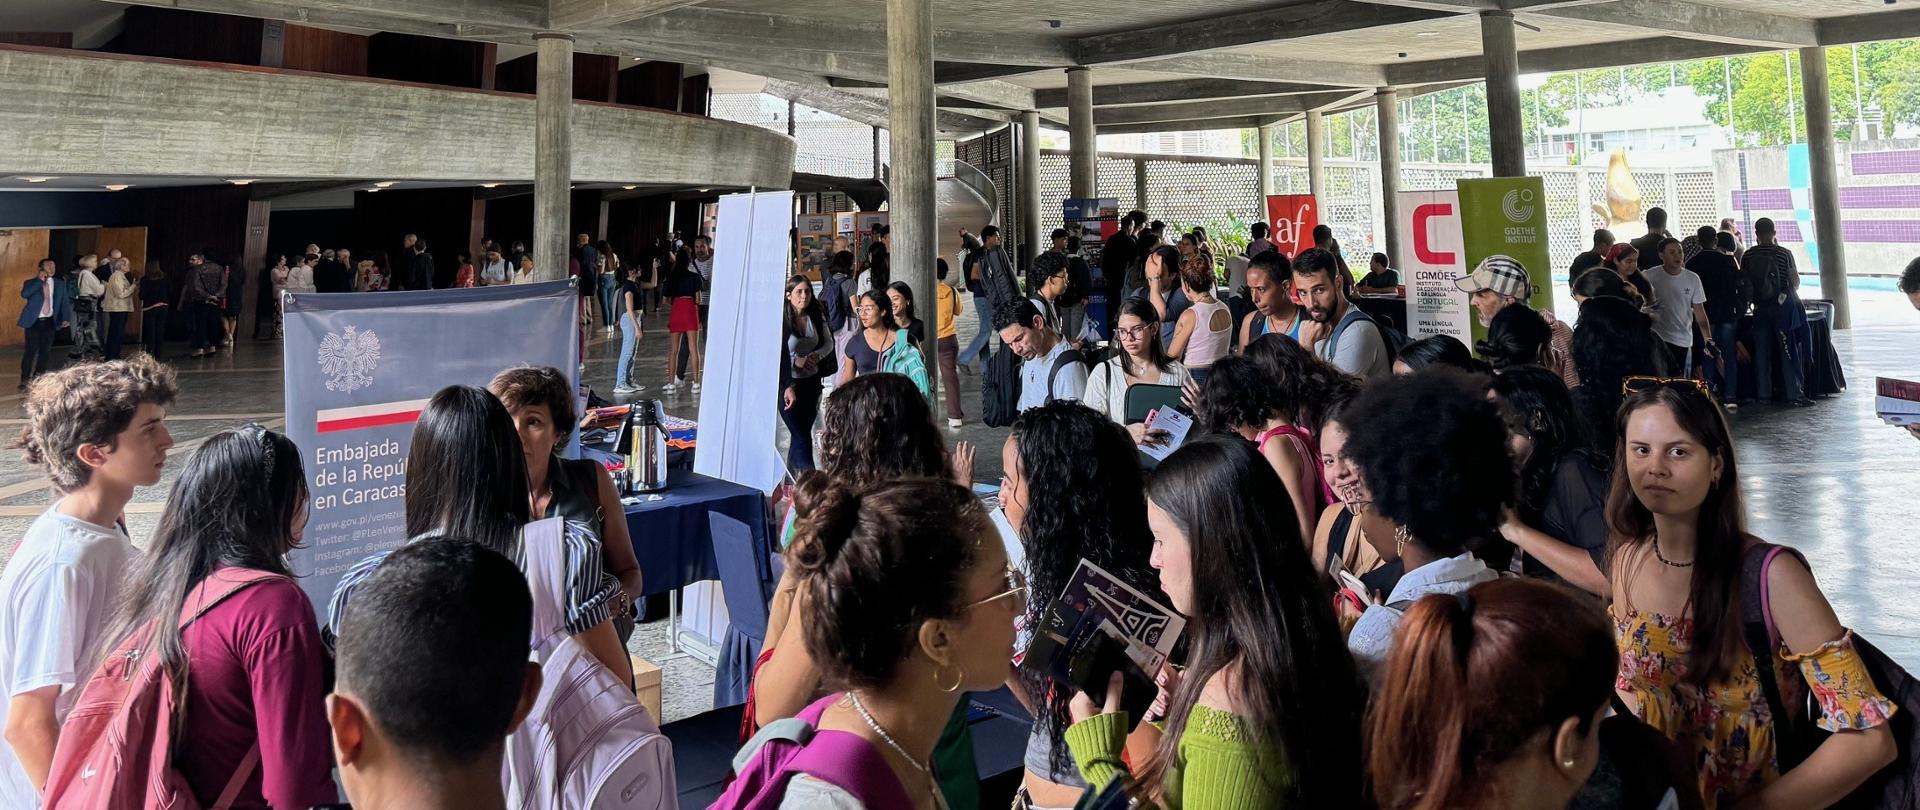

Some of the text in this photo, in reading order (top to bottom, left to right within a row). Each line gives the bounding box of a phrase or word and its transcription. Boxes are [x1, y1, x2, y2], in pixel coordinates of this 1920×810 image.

[1276, 203, 1310, 259] af
[1504, 227, 1537, 235] GOETHE
[1505, 235, 1537, 244] INSTITUT
[1416, 269, 1456, 281] CAMÕES
[1417, 297, 1459, 306] PORTUGAL
[316, 438, 399, 465] Embajada
[315, 468, 337, 487] de
[343, 466, 357, 484] la
[315, 483, 406, 510] en Caracas
[315, 533, 350, 546] Twitter:
[315, 547, 362, 561] Instagram:
